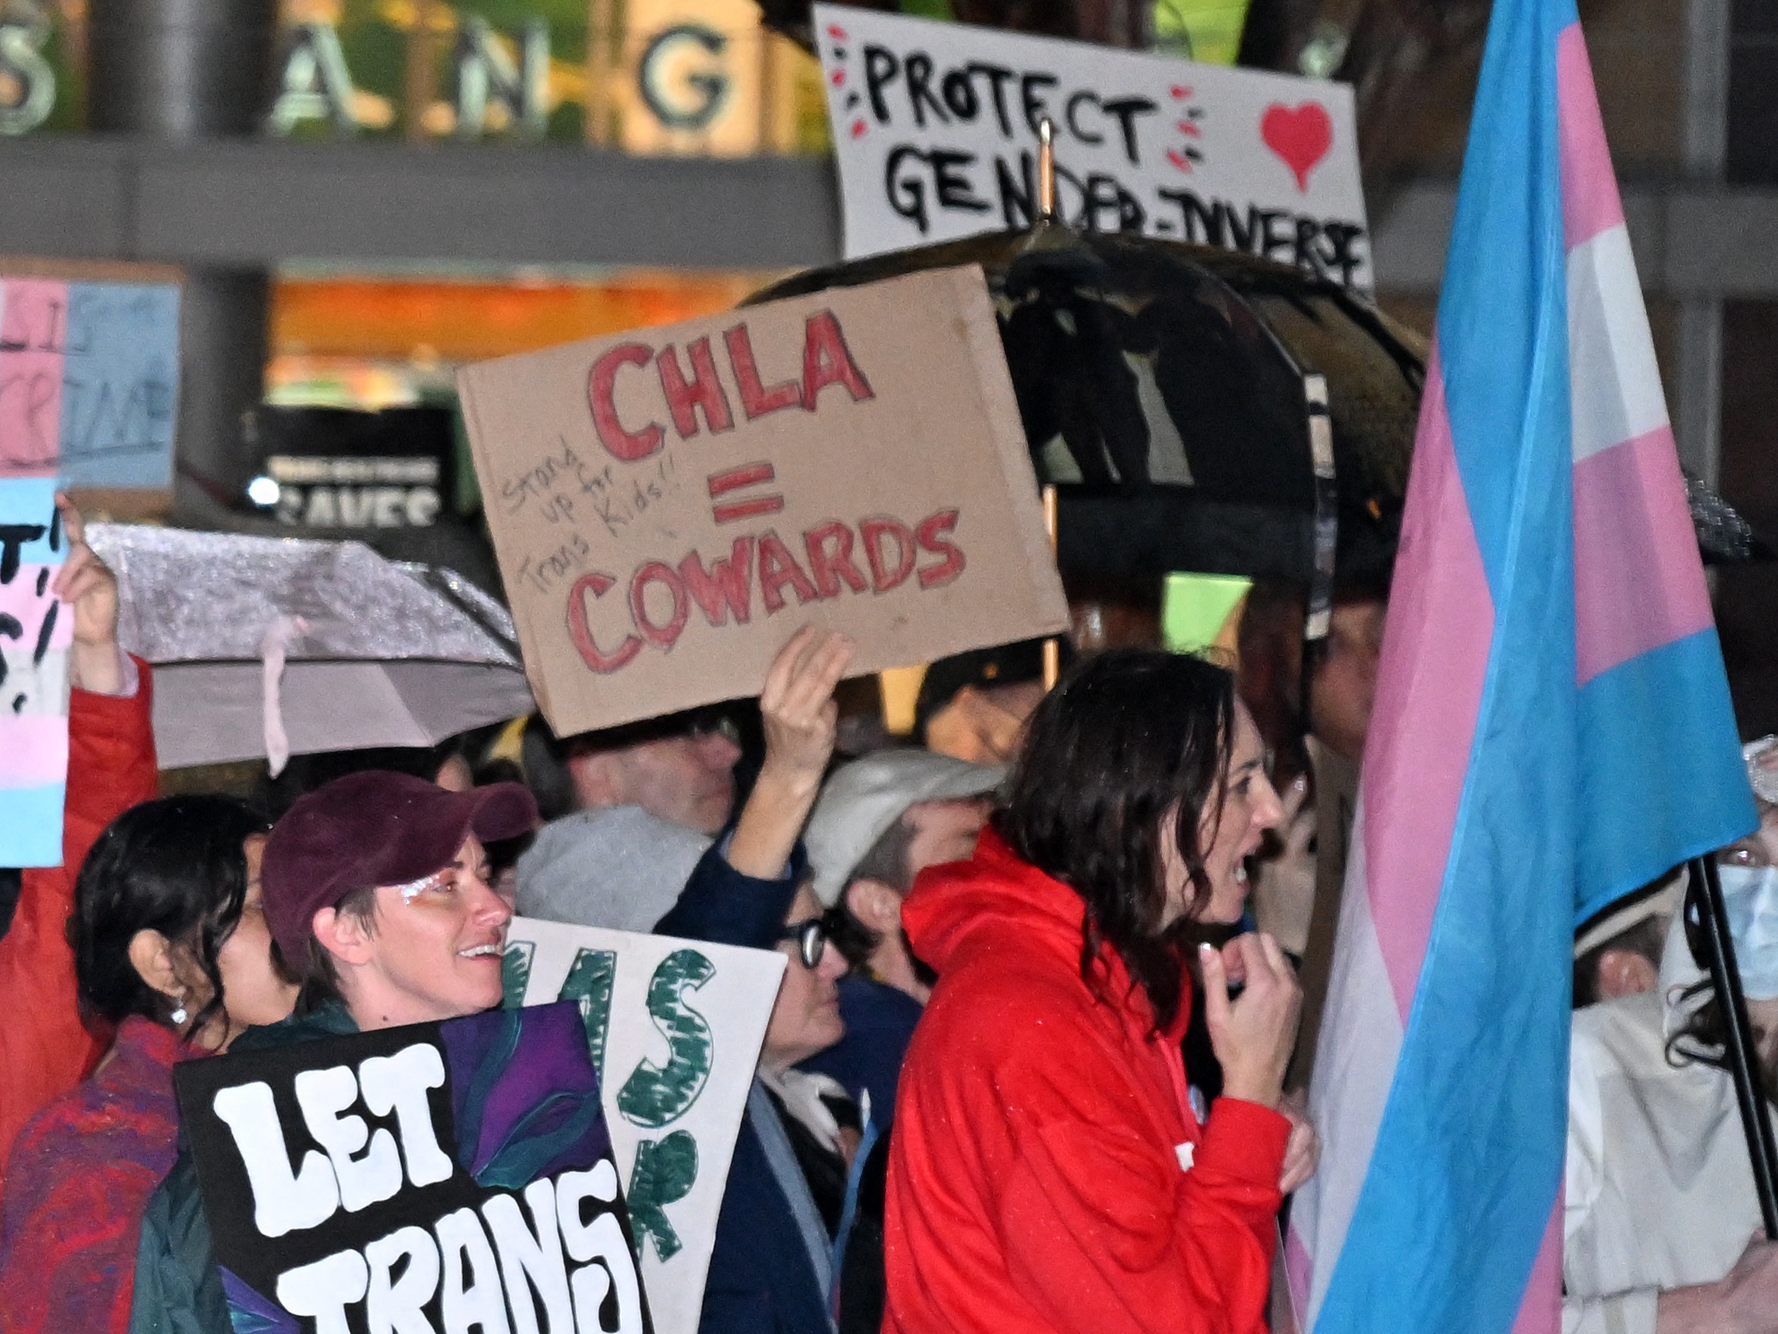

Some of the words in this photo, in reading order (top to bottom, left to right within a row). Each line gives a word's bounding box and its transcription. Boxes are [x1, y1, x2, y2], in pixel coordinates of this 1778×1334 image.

[861, 43, 1158, 166] PROTECT
[586, 306, 876, 463] CHLA
[565, 508, 967, 675] COWARDS
[212, 1041, 455, 1240] LET
